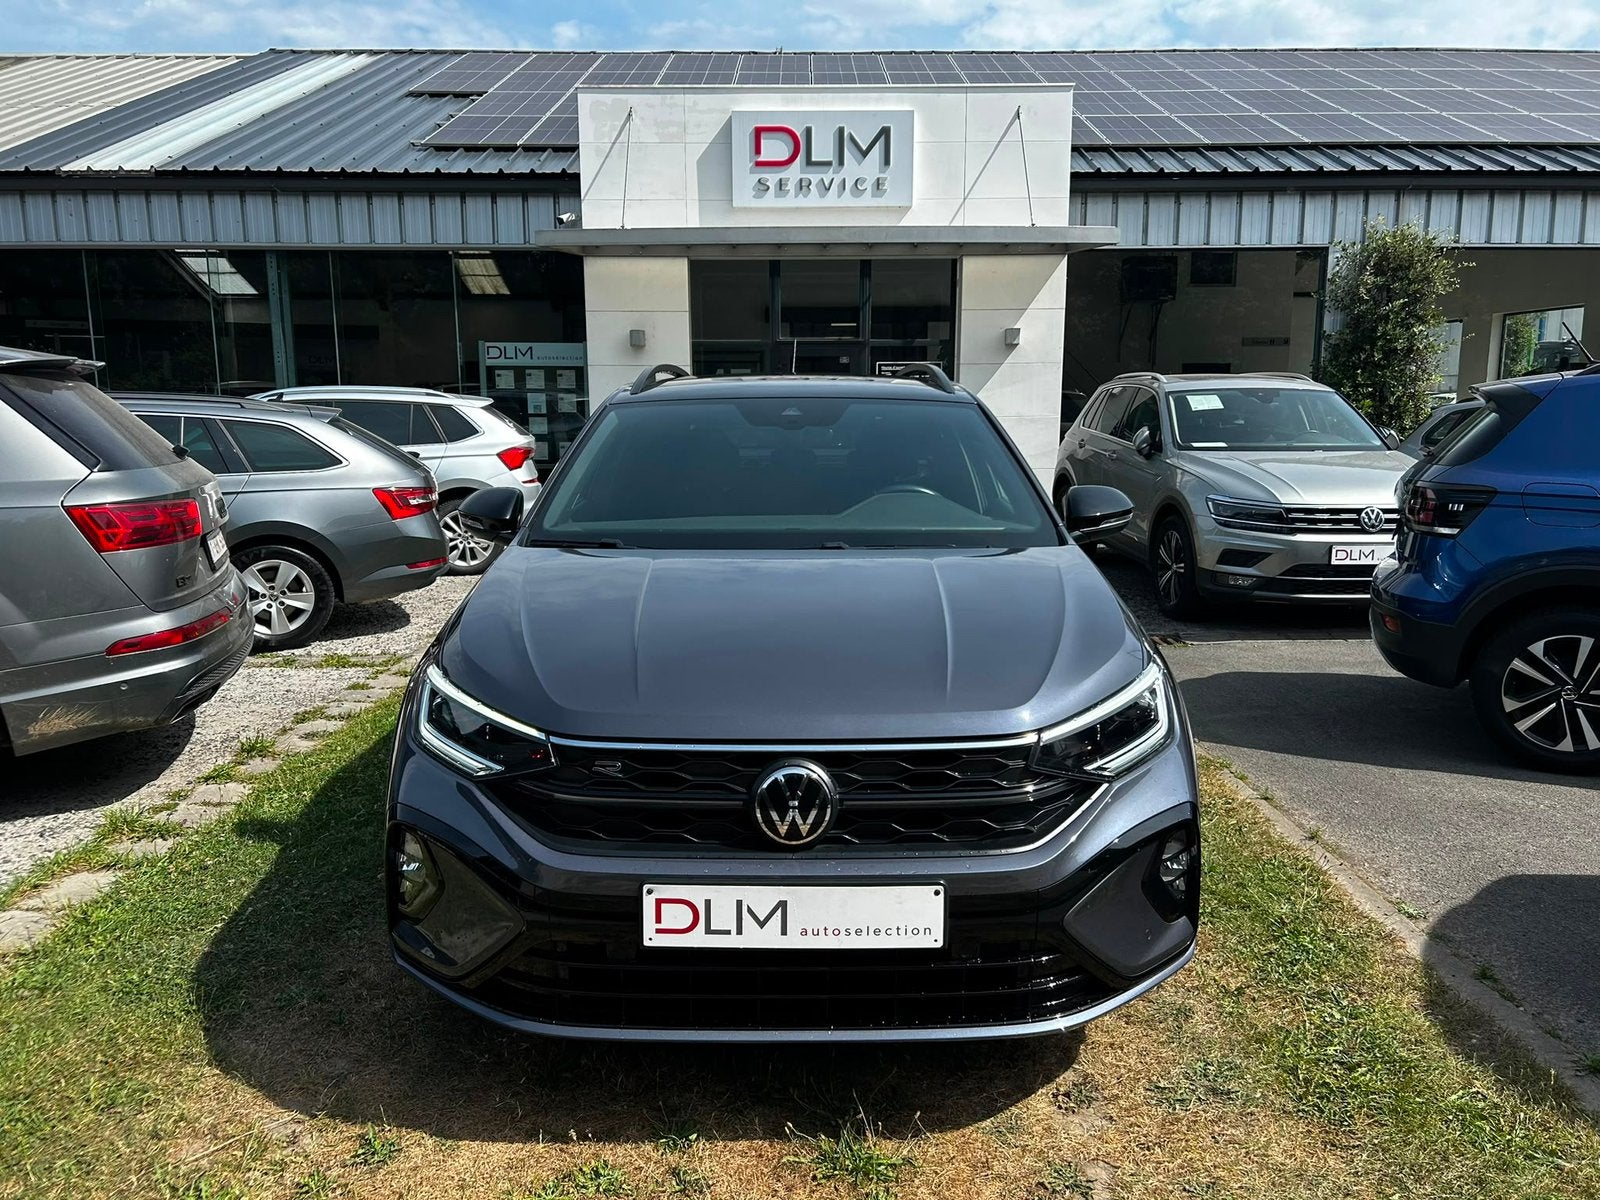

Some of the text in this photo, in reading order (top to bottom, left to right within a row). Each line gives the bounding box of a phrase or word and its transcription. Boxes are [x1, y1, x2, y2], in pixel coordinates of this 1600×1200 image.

[754, 125, 892, 167] DLM
[756, 176, 889, 192] SERVICE
[486, 345, 533, 360] DLM
[1334, 549, 1375, 561] DLM
[655, 897, 933, 938] DLM autoselection
